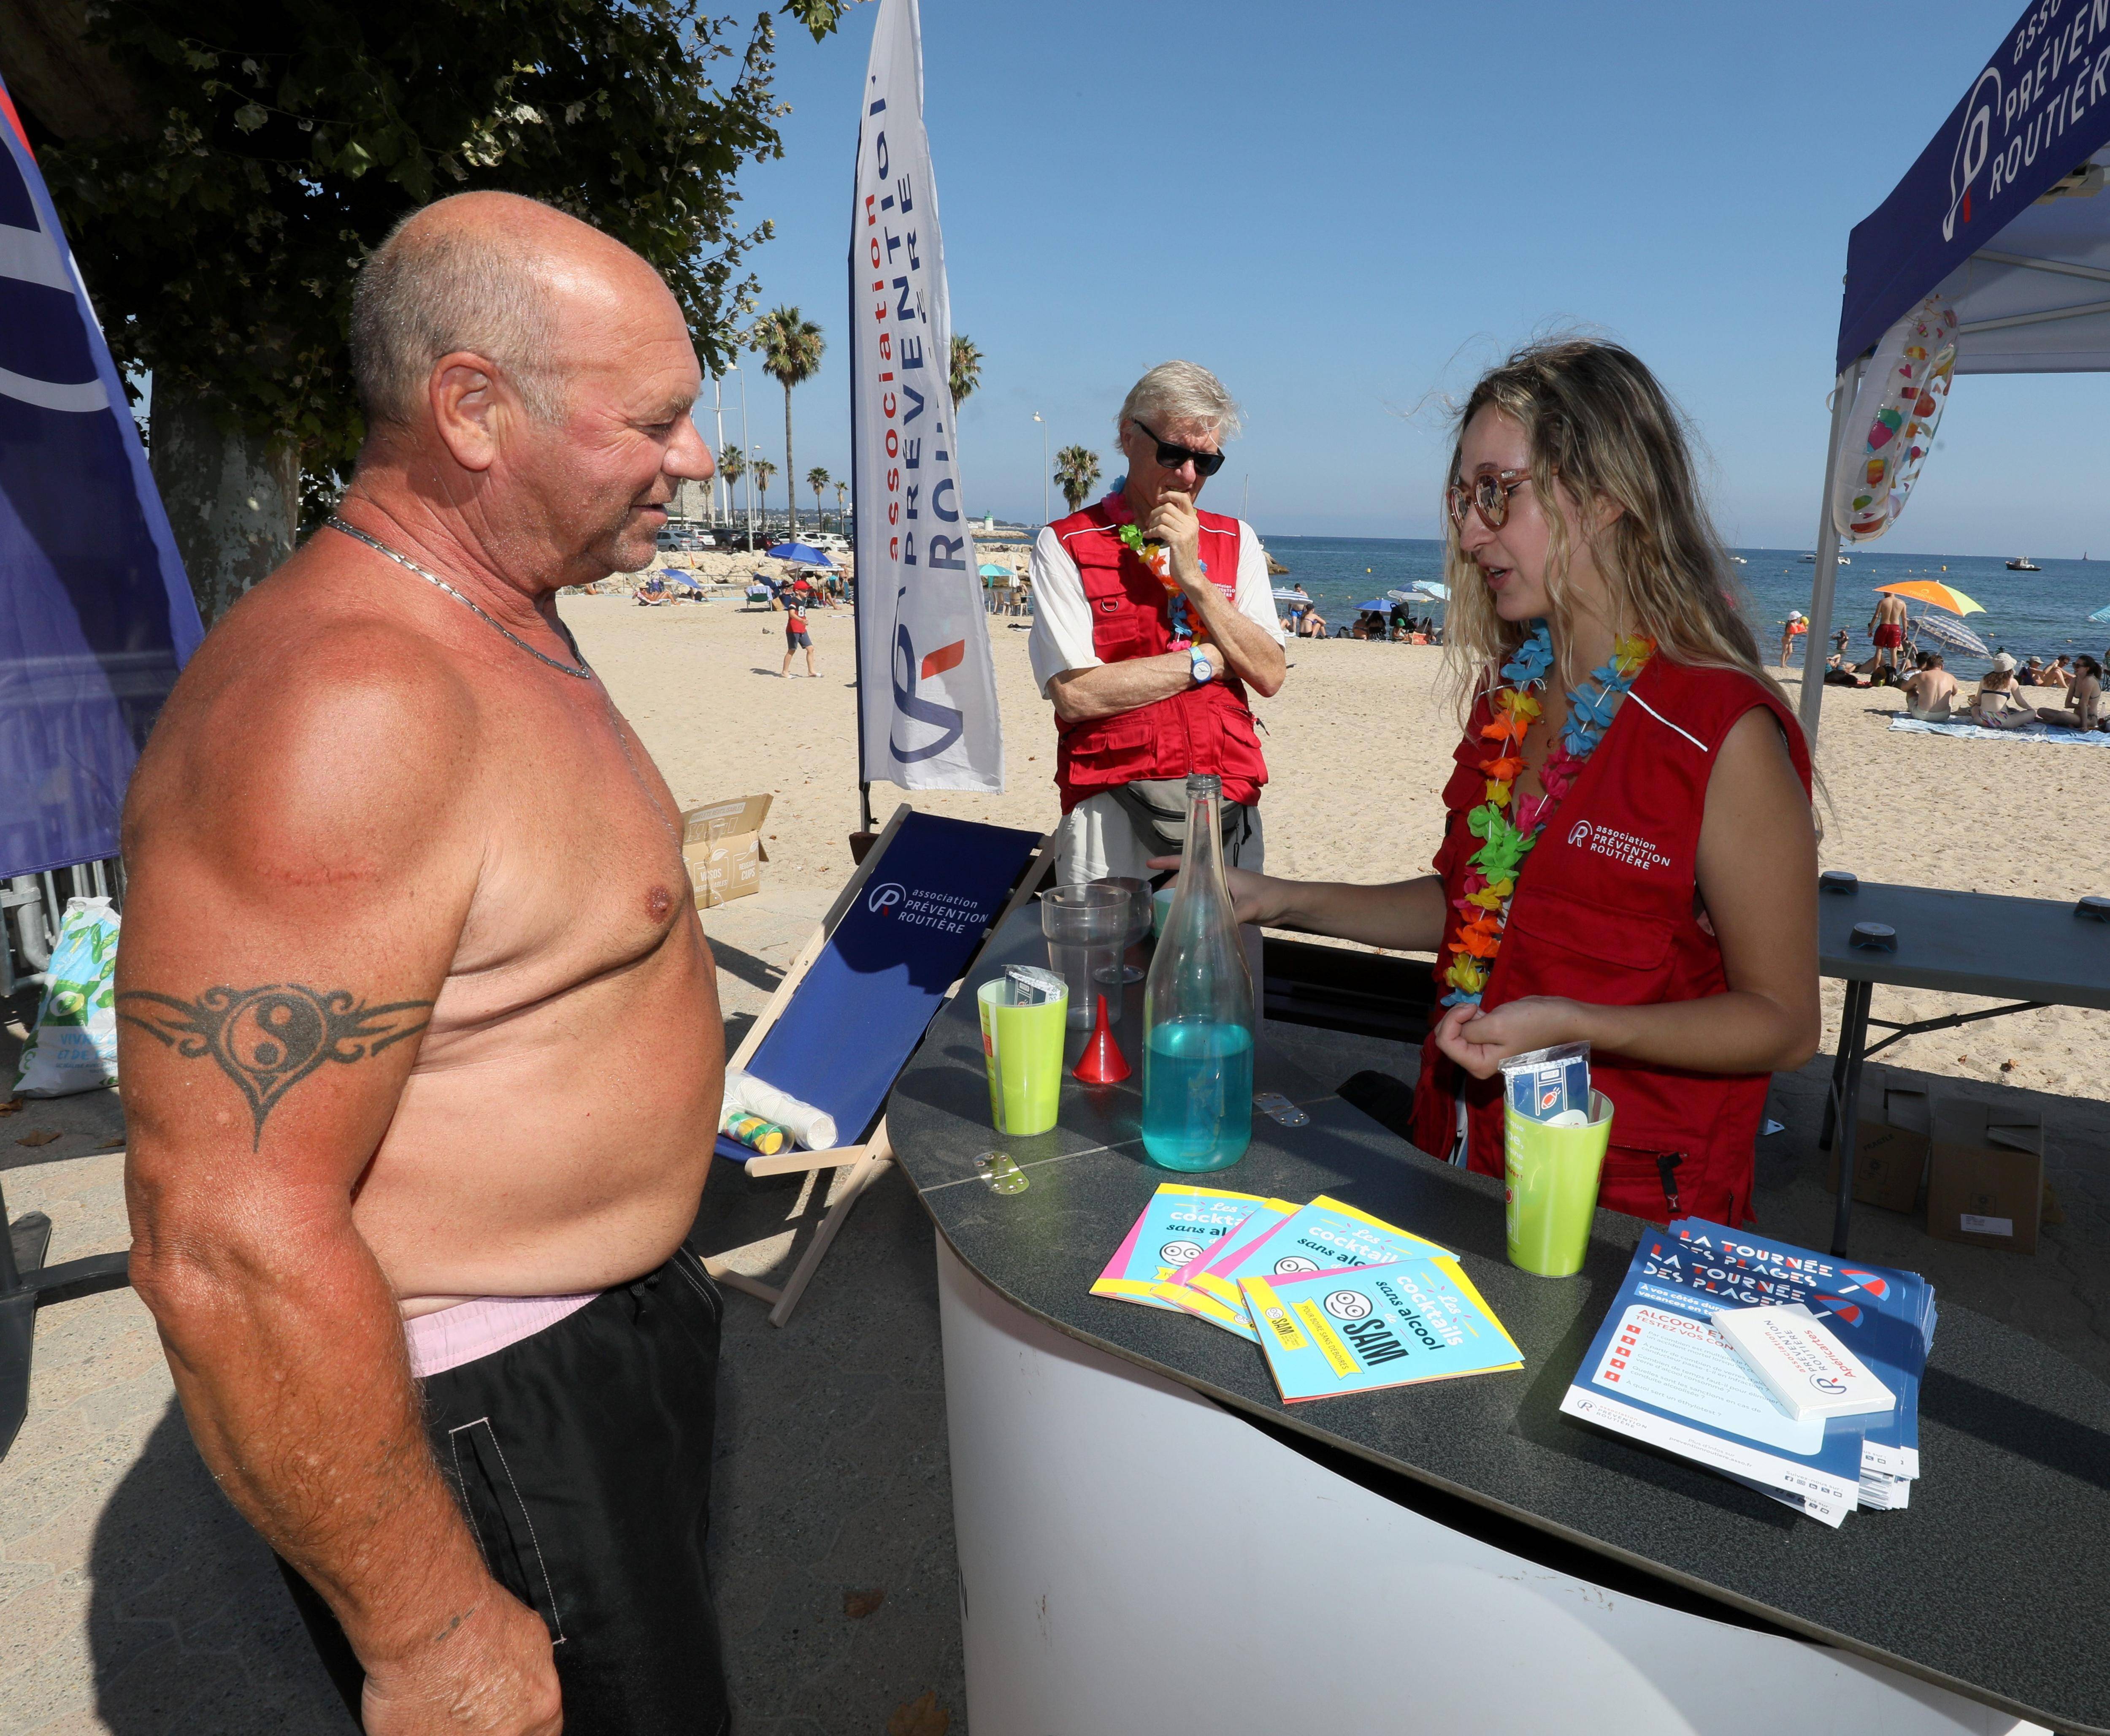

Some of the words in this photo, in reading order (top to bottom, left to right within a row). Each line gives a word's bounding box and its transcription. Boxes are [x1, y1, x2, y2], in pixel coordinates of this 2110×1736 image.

[1593, 834, 1671, 867] PRÉVENTION
[1596, 825, 1656, 851] association
[1591, 843, 1650, 870] ROUTIÈRE
[741, 867, 755, 881] CUPS
[905, 900, 989, 923] PRÉVENTION
[912, 888, 978, 909] association
[898, 911, 966, 934] ROUTIÈRE
[1209, 1202, 1238, 1213] Les
[1166, 1224, 1205, 1234] sans
[1209, 1227, 1227, 1236] al
[1352, 1229, 1381, 1244] Les
[1297, 1238, 1335, 1256] sans
[1308, 1227, 1399, 1263] cocktail
[1680, 1230, 1712, 1248] LA
[1720, 1240, 1833, 1278] TOURNÉE
[1643, 1261, 1684, 1283] DES
[1650, 1243, 1682, 1270] LA
[1691, 1262, 1806, 1303] TOURNÉE
[1679, 1243, 1715, 1261] ES
[1724, 1255, 1818, 1287] PLAGES
[1437, 1295, 1462, 1315] Les
[1638, 1290, 1686, 1308] vacances
[1688, 1305, 1702, 1313] en
[1650, 1286, 1669, 1296] vos
[1670, 1293, 1699, 1305] côtés
[1376, 1281, 1403, 1307] sans
[1398, 1308, 1446, 1350] alcool
[1384, 1313, 1398, 1324] de
[1396, 1276, 1464, 1346] cocktails
[1639, 1309, 1704, 1333] ALCOOL
[1271, 1318, 1295, 1335] SAM
[1302, 1305, 1315, 1318] POUR
[1310, 1318, 1324, 1332] BOIRE
[1320, 1331, 1333, 1345] SANS
[1328, 1345, 1349, 1370] DÉBOIRES
[1635, 1315, 1676, 1332] TESTEZ
[1679, 1329, 1703, 1341] VOS
[1343, 1319, 1409, 1367] SAM
[1657, 1338, 1686, 1351] accident
[1687, 1349, 1711, 1359] mortel
[1661, 1335, 1690, 1348] combien
[1764, 1320, 1818, 1372] PRÉVENTION
[1764, 1332, 1806, 1373] association
[1784, 1330, 1828, 1371] ROUTIÈRE
[1804, 1330, 1857, 1378] Apéricartes
[1636, 1358, 1654, 1367] verre
[1683, 1375, 1724, 1392] consommé
[1637, 1353, 1670, 1368] Combien
[1682, 1369, 1705, 1379] temps
[1706, 1377, 1728, 1388] faut-il
[1729, 1386, 1748, 1395] pour
[1641, 1346, 1682, 1363] conducteur
[1728, 1375, 1764, 1390] infraction
[1650, 1345, 1669, 1354] partir
[1680, 1355, 1711, 1369] combien
[1723, 1370, 1746, 1380] verres
[1630, 1370, 1662, 1384] conduite
[1663, 1382, 1699, 1398] alcoolisée
[1632, 1365, 1658, 1378] Quelles
[1660, 1376, 1677, 1384] sont
[1689, 1386, 1725, 1402] sanctions
[1632, 1384, 1649, 1392] quoi
[1650, 1389, 1665, 1397] sert
[1677, 1398, 1716, 1415] éthylotest
[1599, 1405, 1638, 1421] association
[1669, 1437, 1753, 1468] preventionroutiere.asso.fr
[1688, 1438, 1702, 1446] Plus
[1786, 1471, 1828, 1487] Suivez-nous
